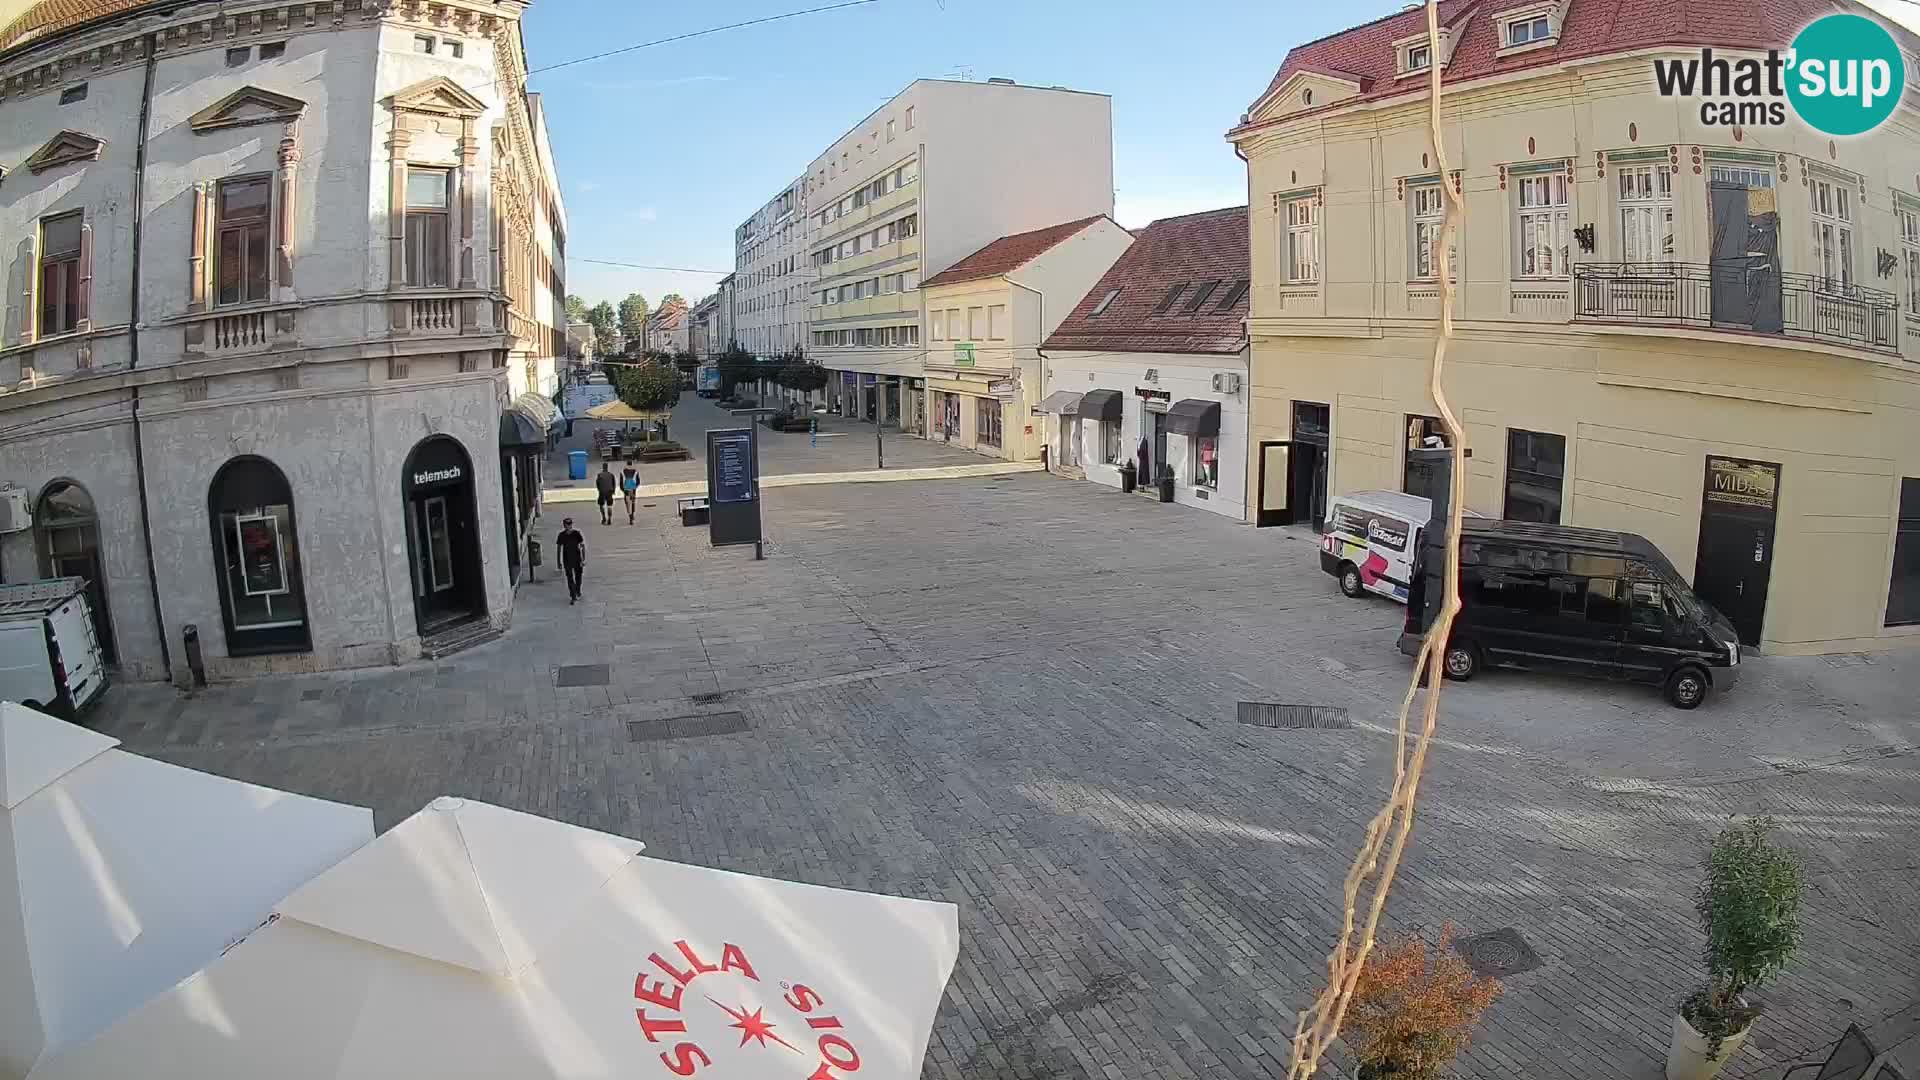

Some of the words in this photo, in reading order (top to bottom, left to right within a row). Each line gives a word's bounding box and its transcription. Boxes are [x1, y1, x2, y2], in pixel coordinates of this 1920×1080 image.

[414, 466, 460, 485] telemach
[634, 939, 761, 1077] STELLA
[784, 983, 861, 1080] OIS
